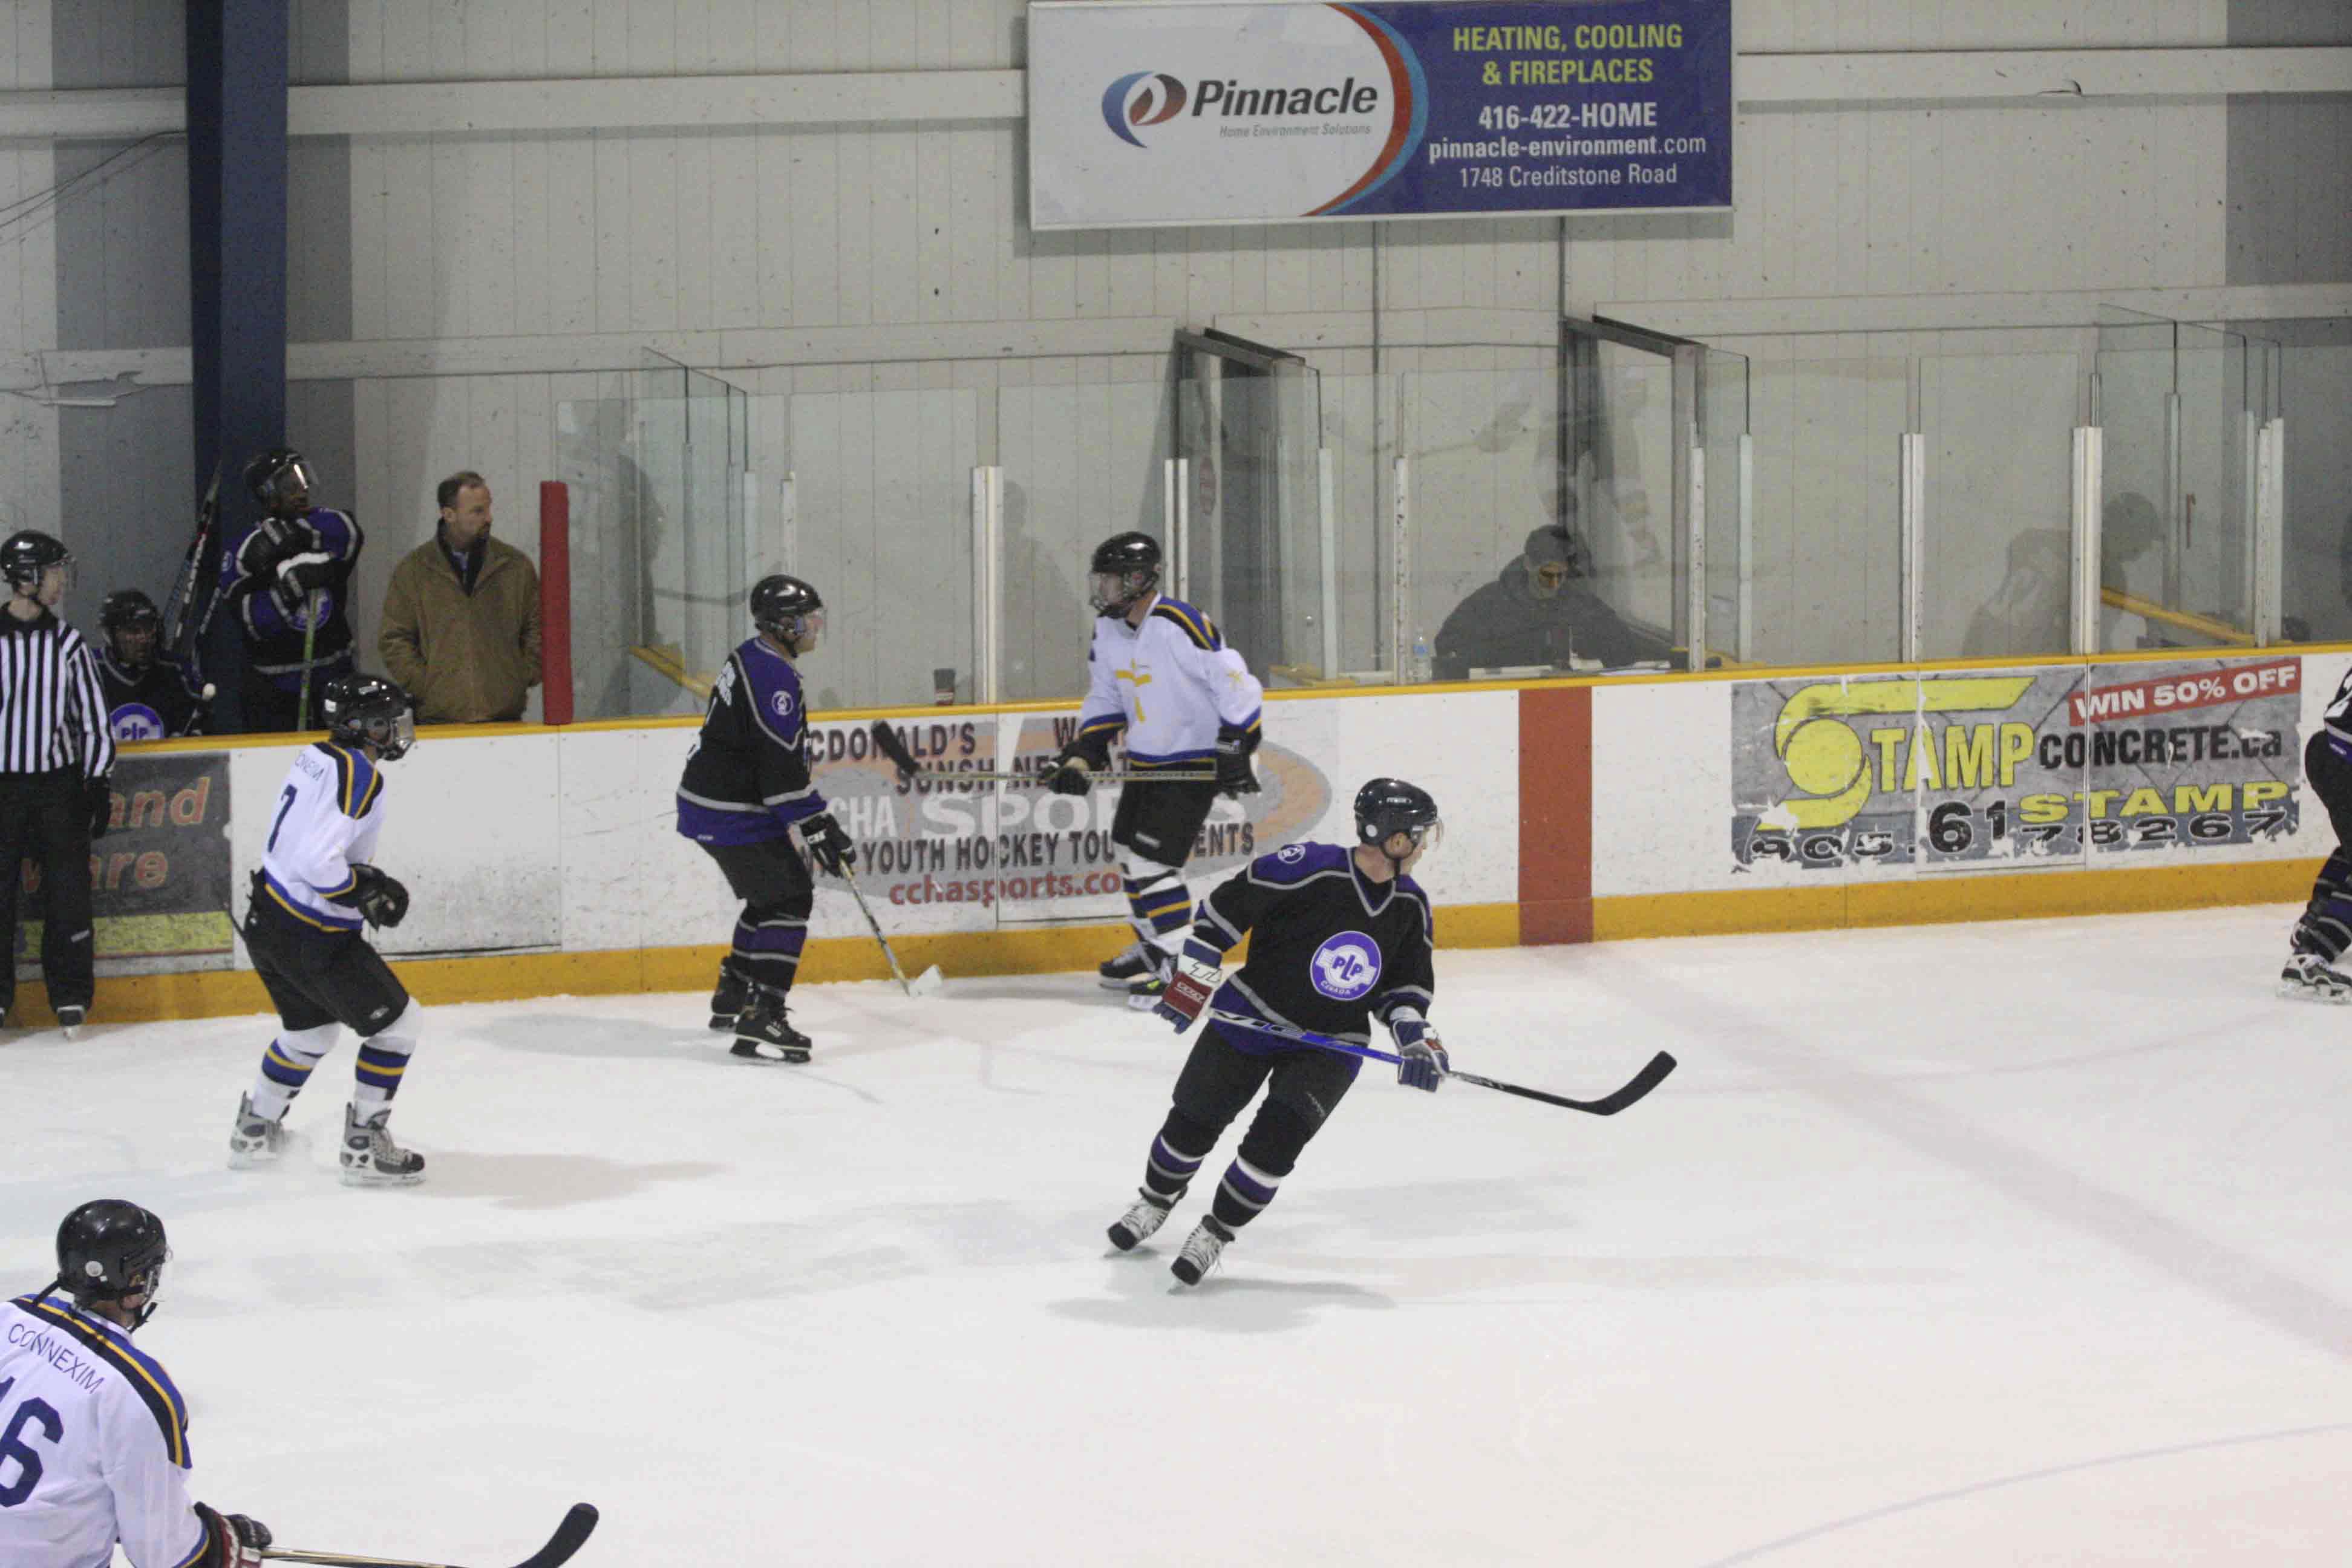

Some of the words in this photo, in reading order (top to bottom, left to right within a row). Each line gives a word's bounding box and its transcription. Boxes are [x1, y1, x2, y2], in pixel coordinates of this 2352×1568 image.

[1452, 25, 1567, 52] HEATING,
[1575, 24, 1683, 49] COOLING
[1482, 60, 1502, 85] &
[1509, 58, 1654, 85] FIREPLACES
[1191, 77, 1378, 117] Pinnacle
[1479, 102, 1657, 129] 416-422-HOME
[1219, 125, 1249, 138] Home
[1253, 123, 1318, 137] Environment
[1321, 122, 1371, 136] Solutions
[1429, 135, 1707, 164] pinnacle-environment.com
[1460, 166, 1503, 188] 1748
[1509, 165, 1621, 187] Creditstone
[1628, 163, 1677, 184] Road
[2075, 687, 2145, 719] WIN
[2153, 676, 2227, 707] 50%
[2233, 665, 2297, 694] OFF
[861, 837, 946, 875] YOUTH
[956, 832, 1059, 871] HOCKEY
[8, 1323, 105, 1394] CONNEXIM
